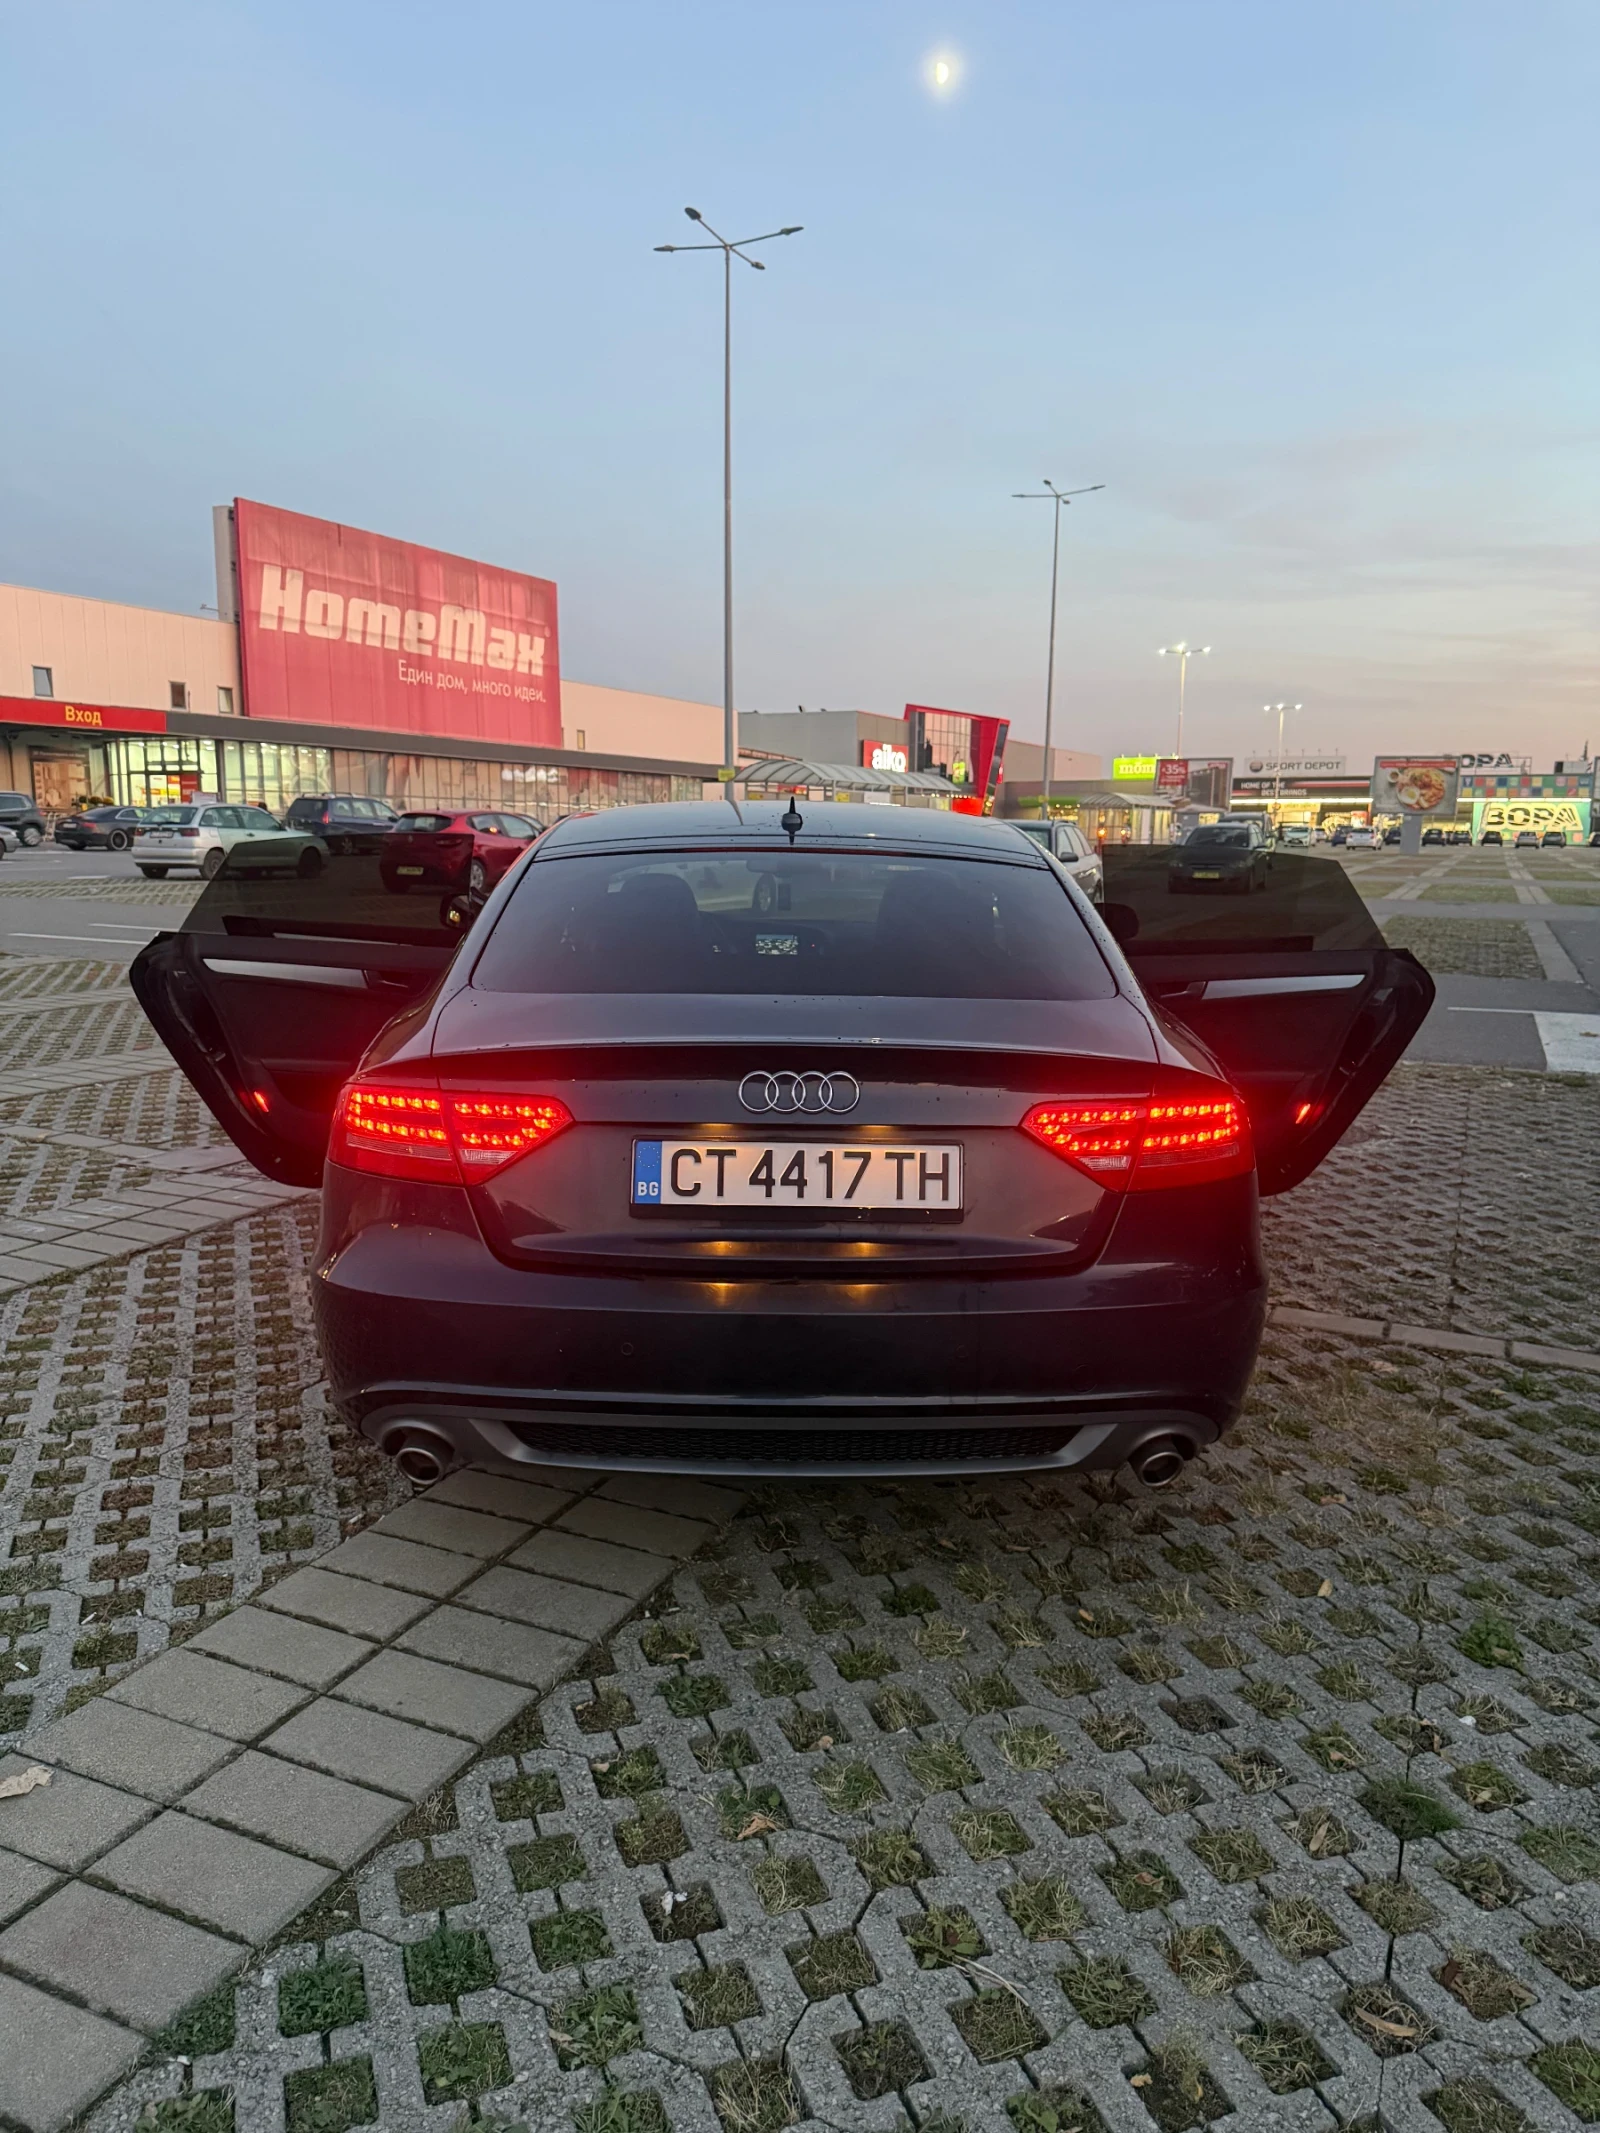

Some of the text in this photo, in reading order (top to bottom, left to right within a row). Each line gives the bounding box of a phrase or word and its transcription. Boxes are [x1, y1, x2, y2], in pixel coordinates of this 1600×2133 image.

[398, 659, 546, 702] Един дом, много идеи.
[65, 705, 102, 726] Вход
[872, 744, 906, 772] aiko
[1305, 761, 1341, 770] DEPOT
[1241, 781, 1260, 789] HOME
[1261, 781, 1270, 789] OF
[671, 1148, 949, 1201] CT 4417 TH
[637, 1181, 659, 1196] BG
